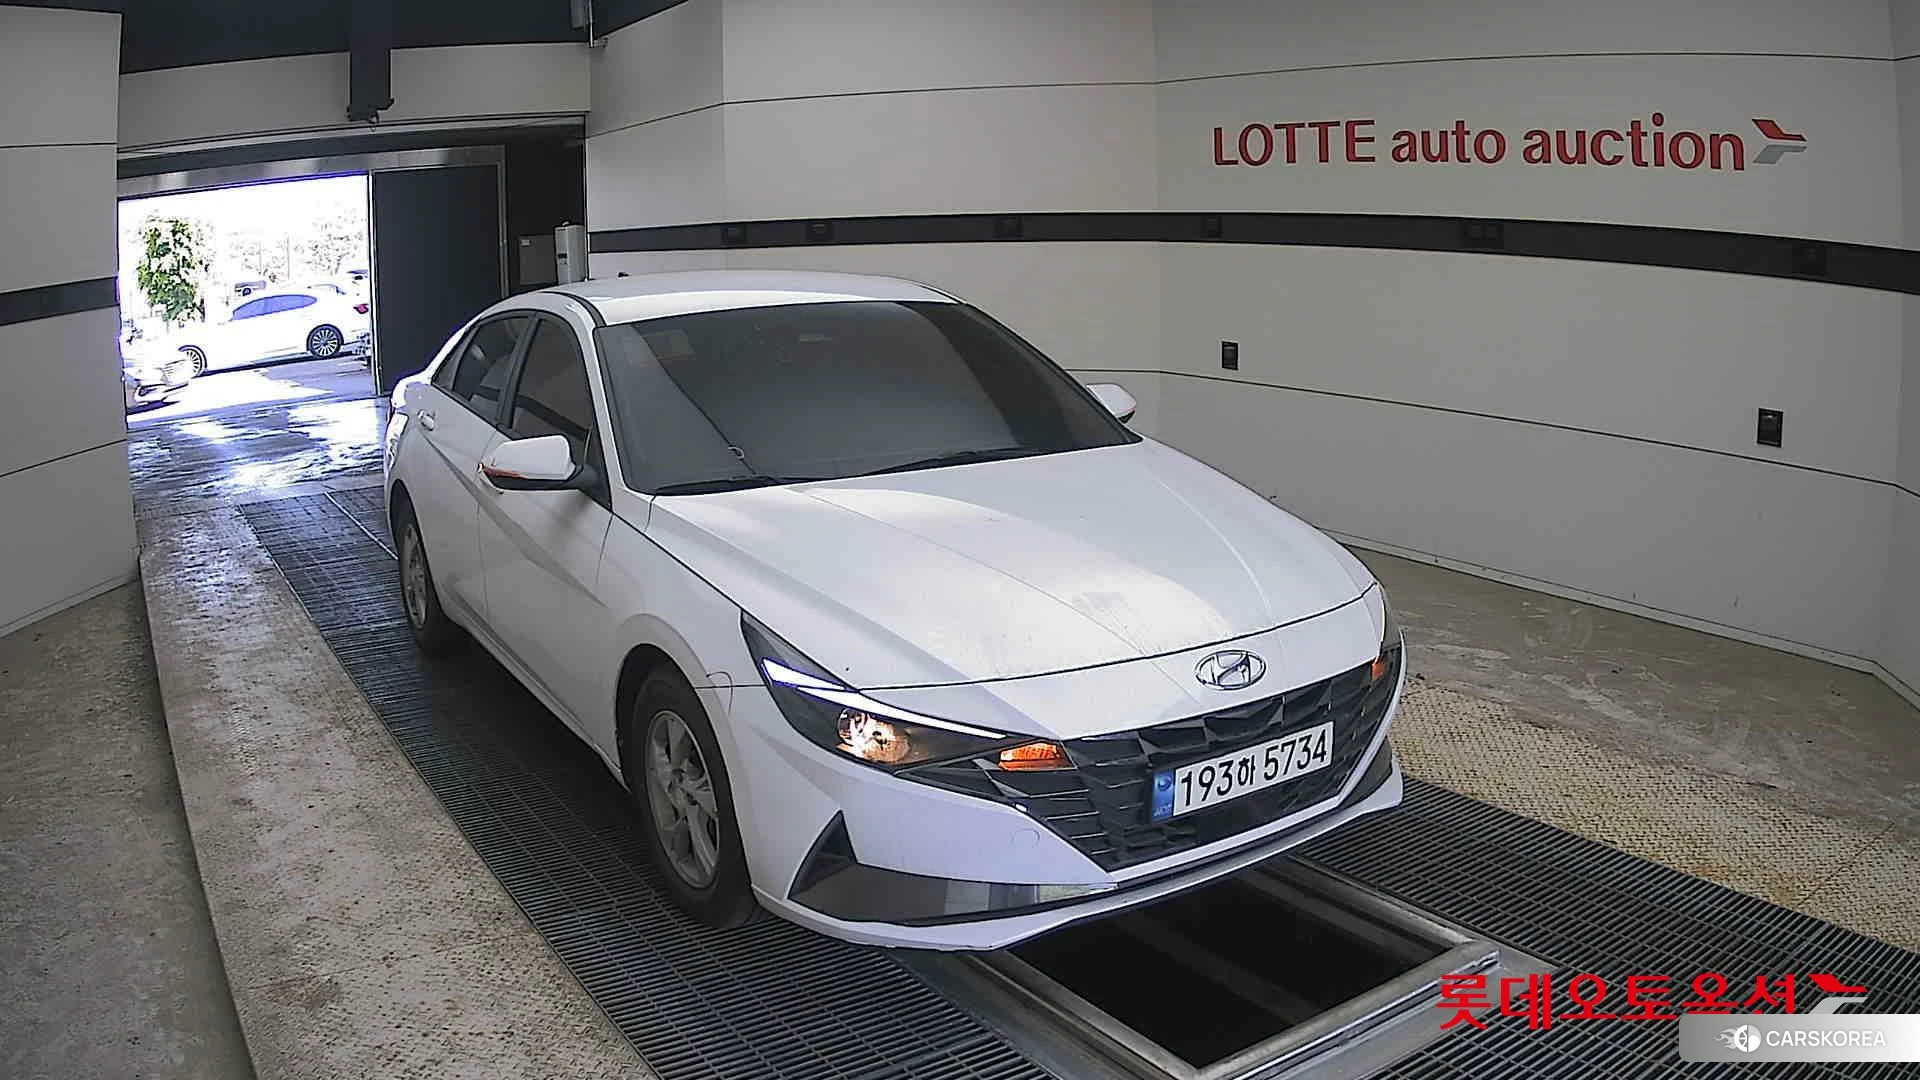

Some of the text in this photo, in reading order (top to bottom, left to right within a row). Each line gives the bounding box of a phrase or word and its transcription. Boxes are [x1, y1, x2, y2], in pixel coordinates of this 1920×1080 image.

[1213, 112, 1745, 171] LOTTE auto auction
[1181, 729, 1327, 806] 193하 5734
